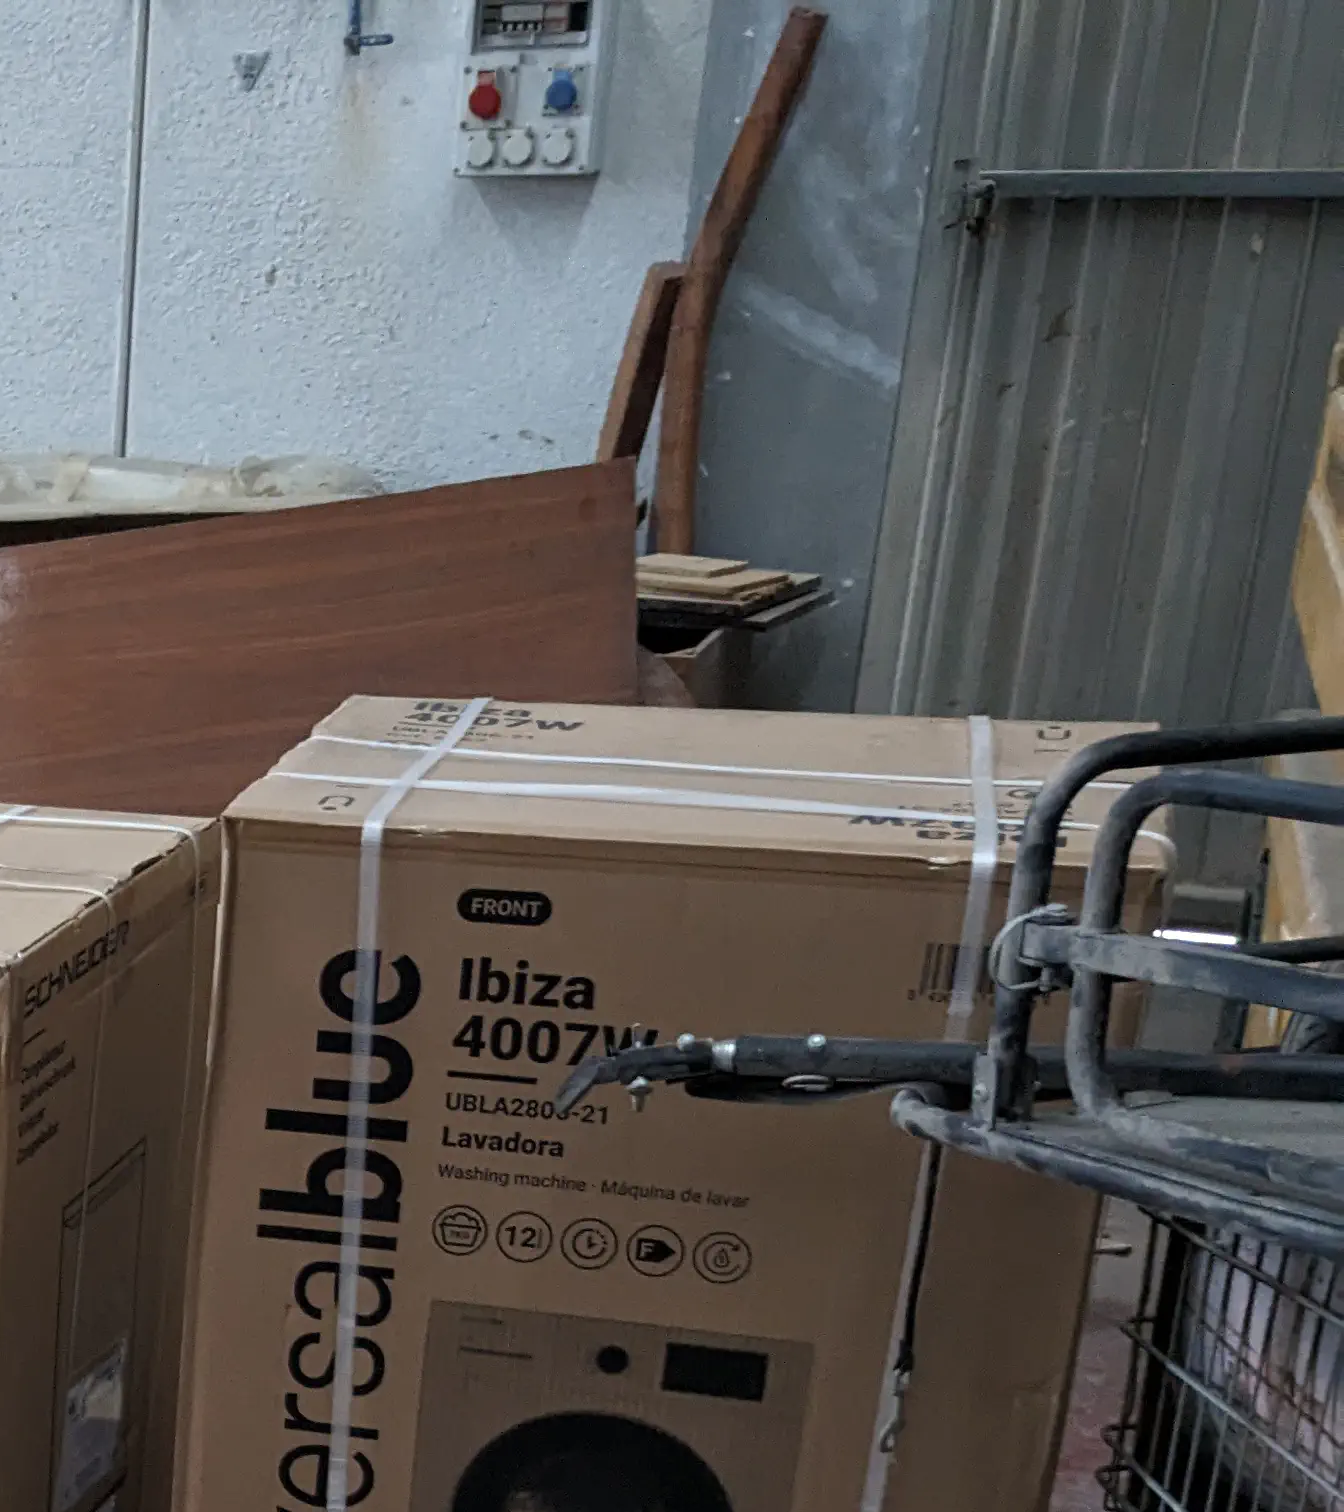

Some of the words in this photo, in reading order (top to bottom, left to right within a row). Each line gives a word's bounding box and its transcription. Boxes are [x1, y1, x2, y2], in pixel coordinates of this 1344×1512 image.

[413, 701, 532, 718] Ibza
[470, 897, 544, 918] FRONT
[23, 920, 130, 1018] SCHNEIDER
[459, 956, 595, 1010] Ibiza
[445, 1092, 609, 1125] UBLA280-21
[441, 1126, 565, 1158] Lavadora
[438, 1163, 510, 1186] Washing
[514, 1171, 586, 1192] machine
[601, 1178, 676, 1201] Máquina
[681, 1188, 702, 1204] de
[706, 1191, 750, 1208] lavar
